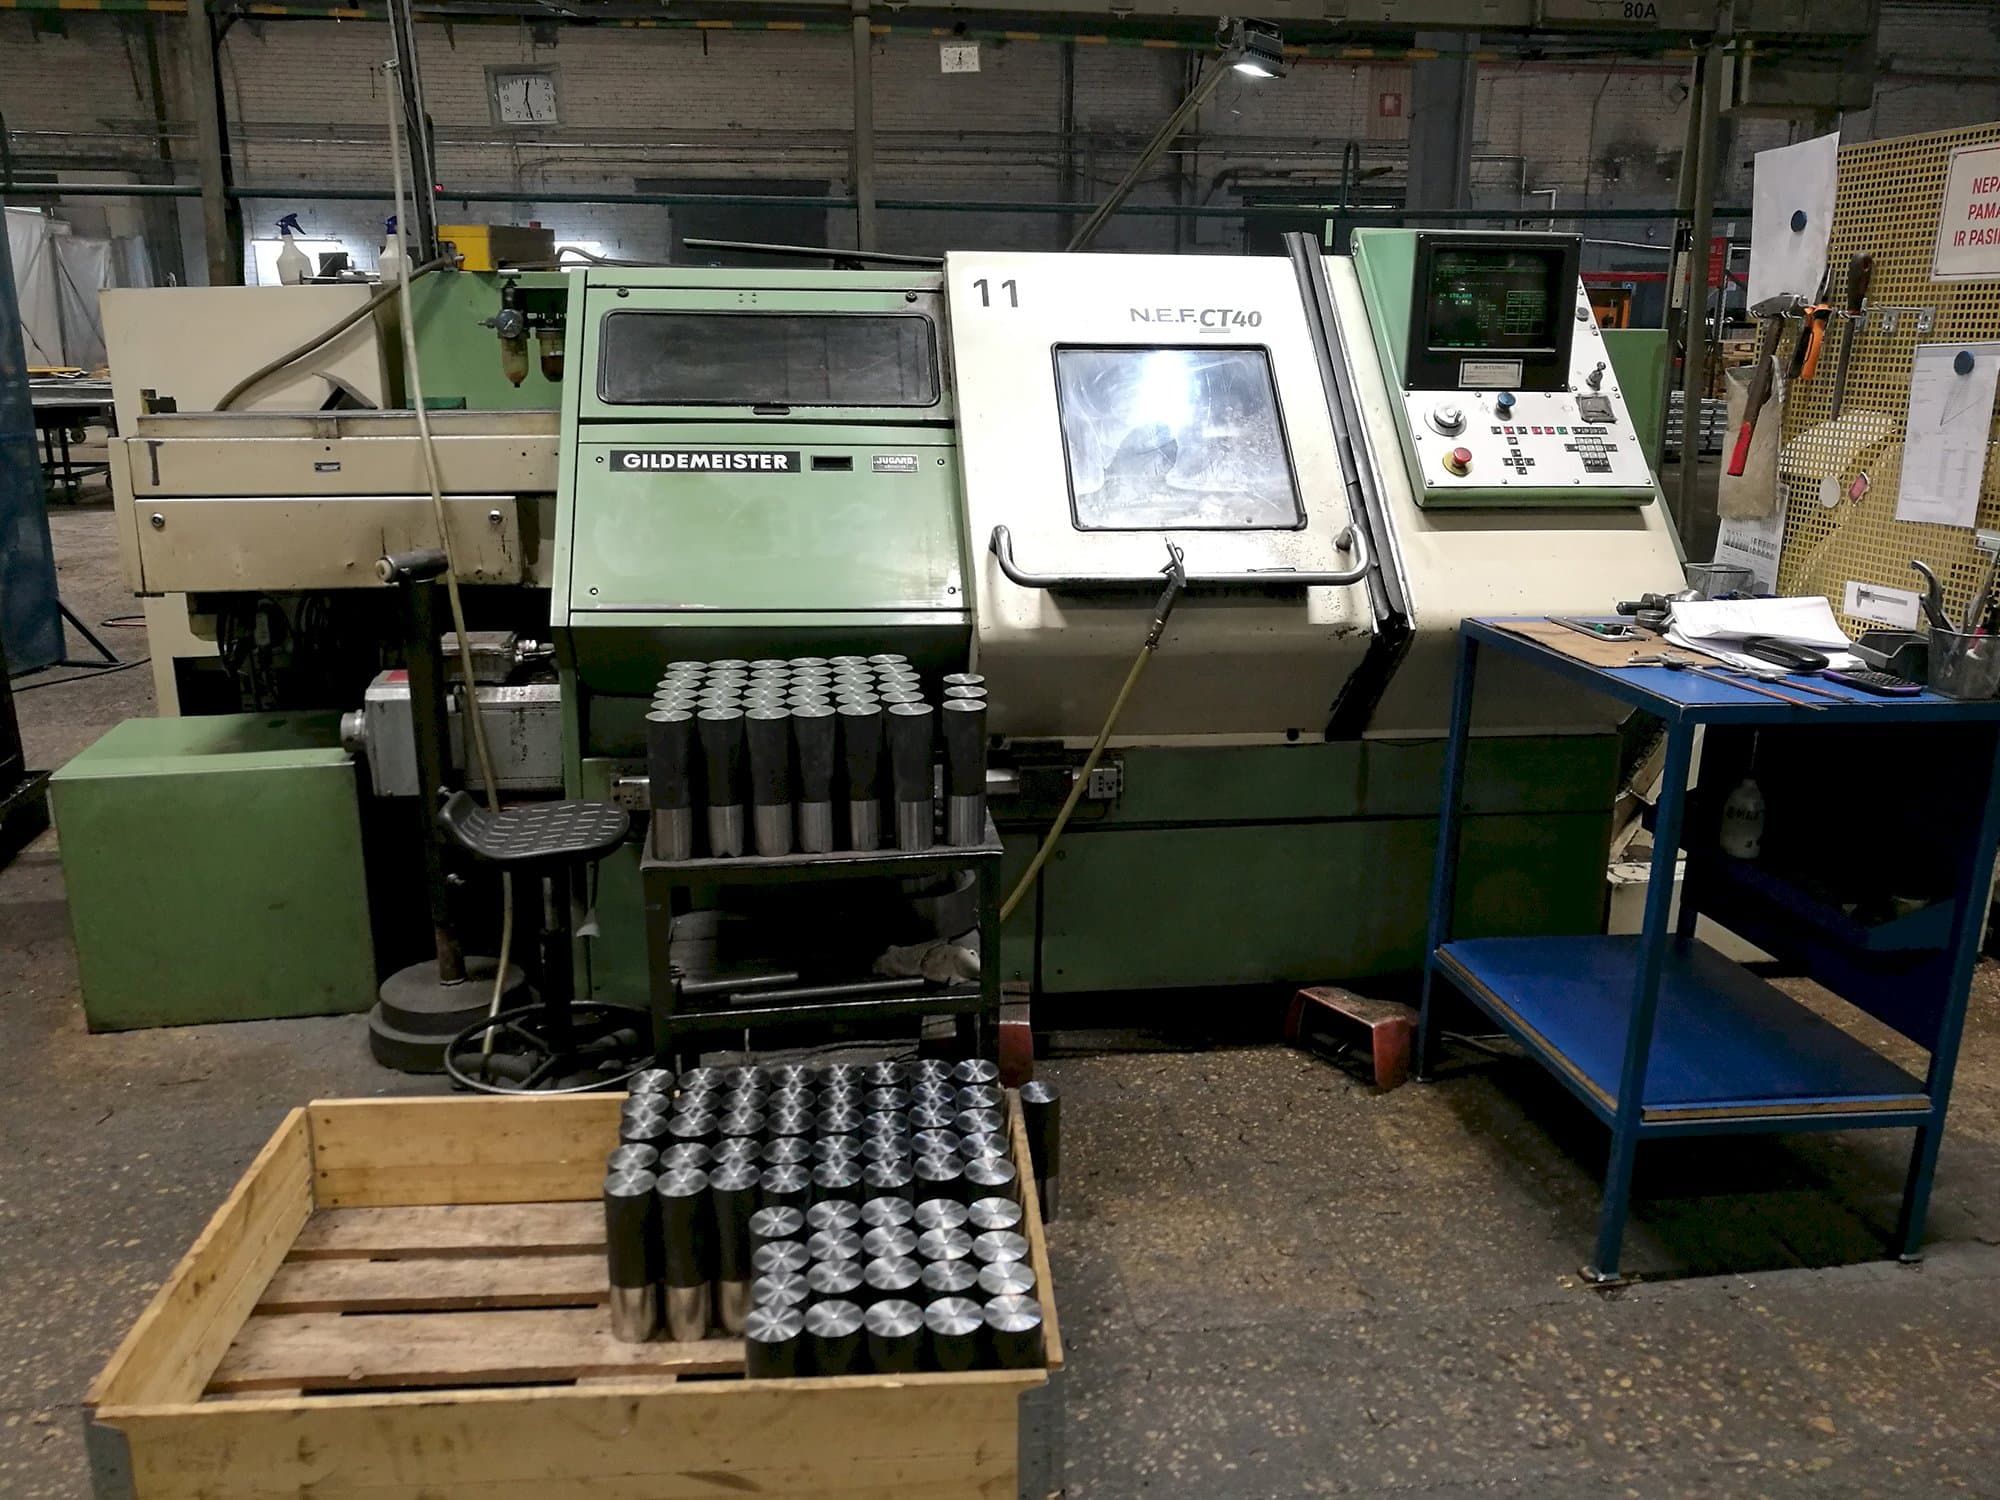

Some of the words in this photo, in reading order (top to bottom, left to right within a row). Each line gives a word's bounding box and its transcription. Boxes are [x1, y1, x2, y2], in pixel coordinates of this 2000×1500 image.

[1623, 2, 1656, 18] 80A
[1953, 230, 1966, 247] IR
[1968, 228, 2000, 246] PASI
[973, 279, 1019, 308] 11
[623, 453, 788, 470] GILDEMEISTER
